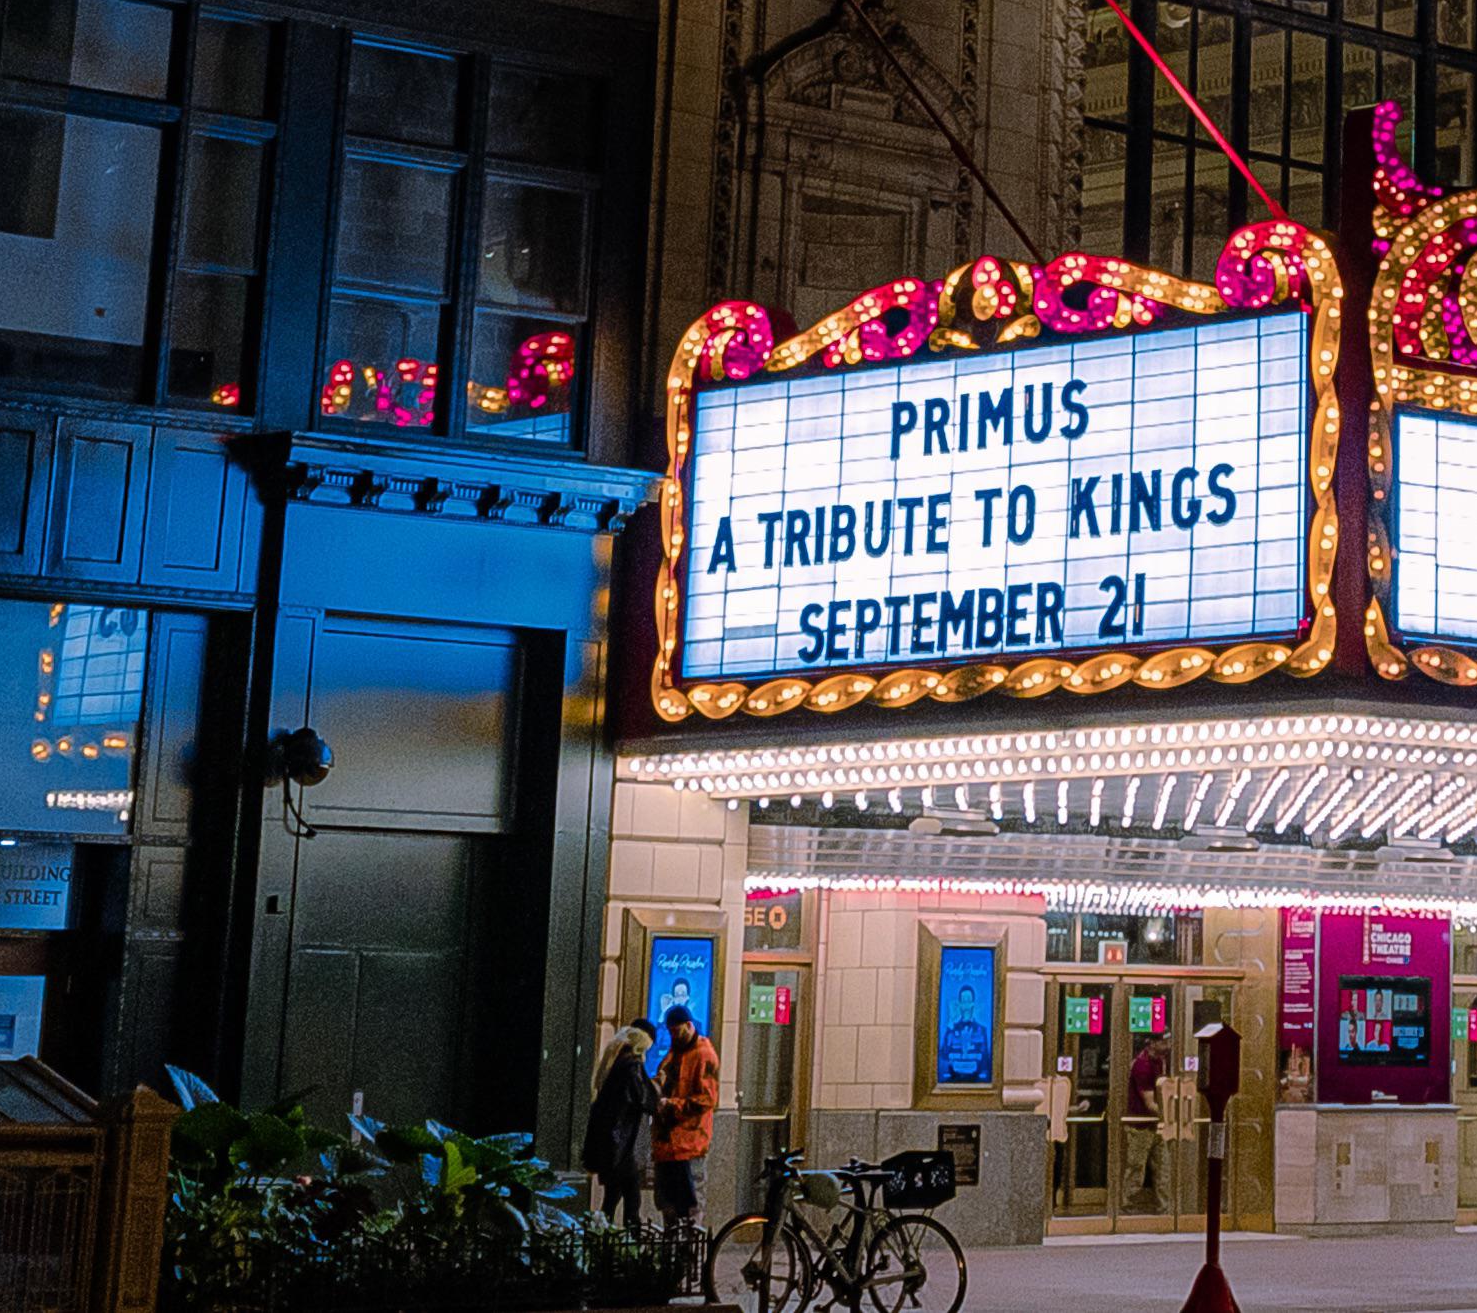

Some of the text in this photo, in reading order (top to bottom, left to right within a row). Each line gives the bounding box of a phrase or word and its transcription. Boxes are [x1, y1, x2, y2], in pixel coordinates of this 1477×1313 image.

[890, 378, 1089, 460] PRIMUS
[707, 463, 1237, 574] A TRIBUTE TO KINGS
[798, 573, 1146, 664] SEPTEMBER 21
[3, 889, 62, 906] STREET
[1370, 932, 1411, 943] CHICAGO
[1370, 943, 1411, 956] THEATRE
